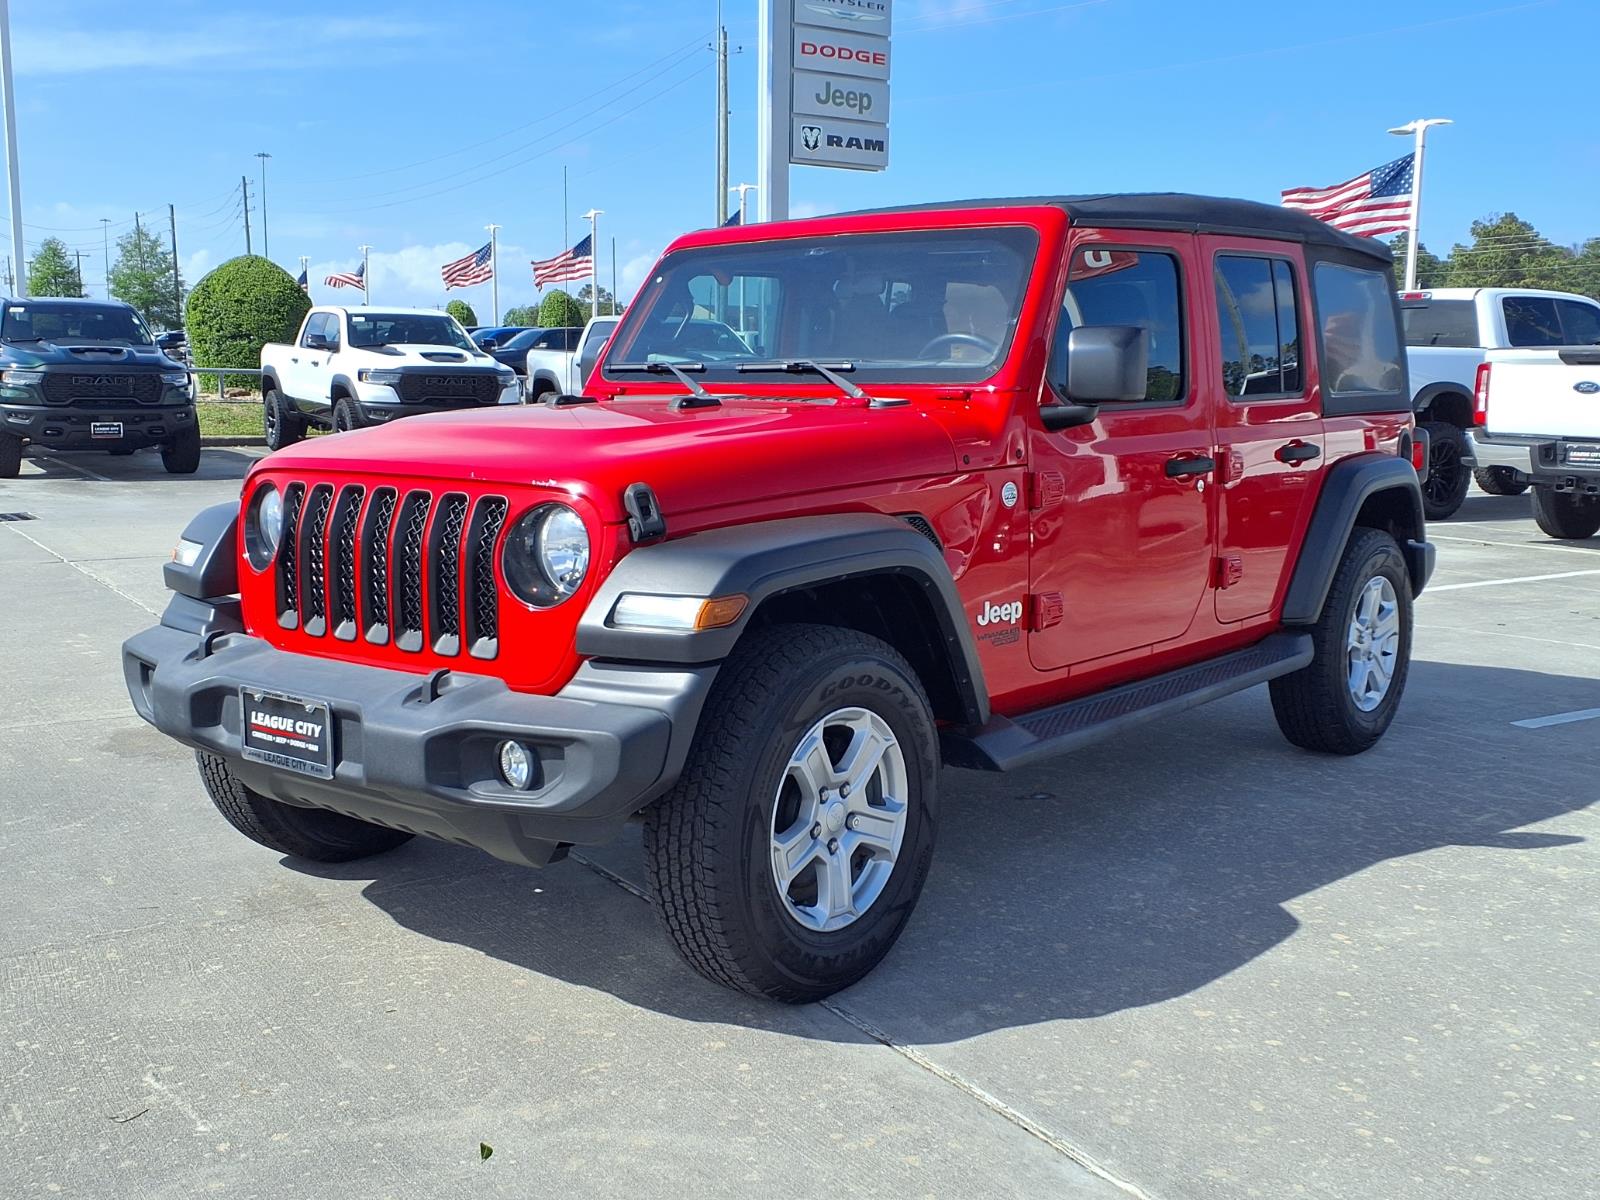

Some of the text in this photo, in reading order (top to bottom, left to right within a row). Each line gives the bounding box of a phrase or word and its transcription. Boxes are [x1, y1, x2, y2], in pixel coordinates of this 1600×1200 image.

[801, 42, 886, 65] DODGE
[815, 81, 873, 114] Jeep
[826, 134, 885, 152] RAM
[977, 601, 1023, 626] Jeep
[251, 711, 323, 738] LEAGUE CITY
[263, 753, 290, 767] LEAGUE
[291, 760, 308, 771] CITY
